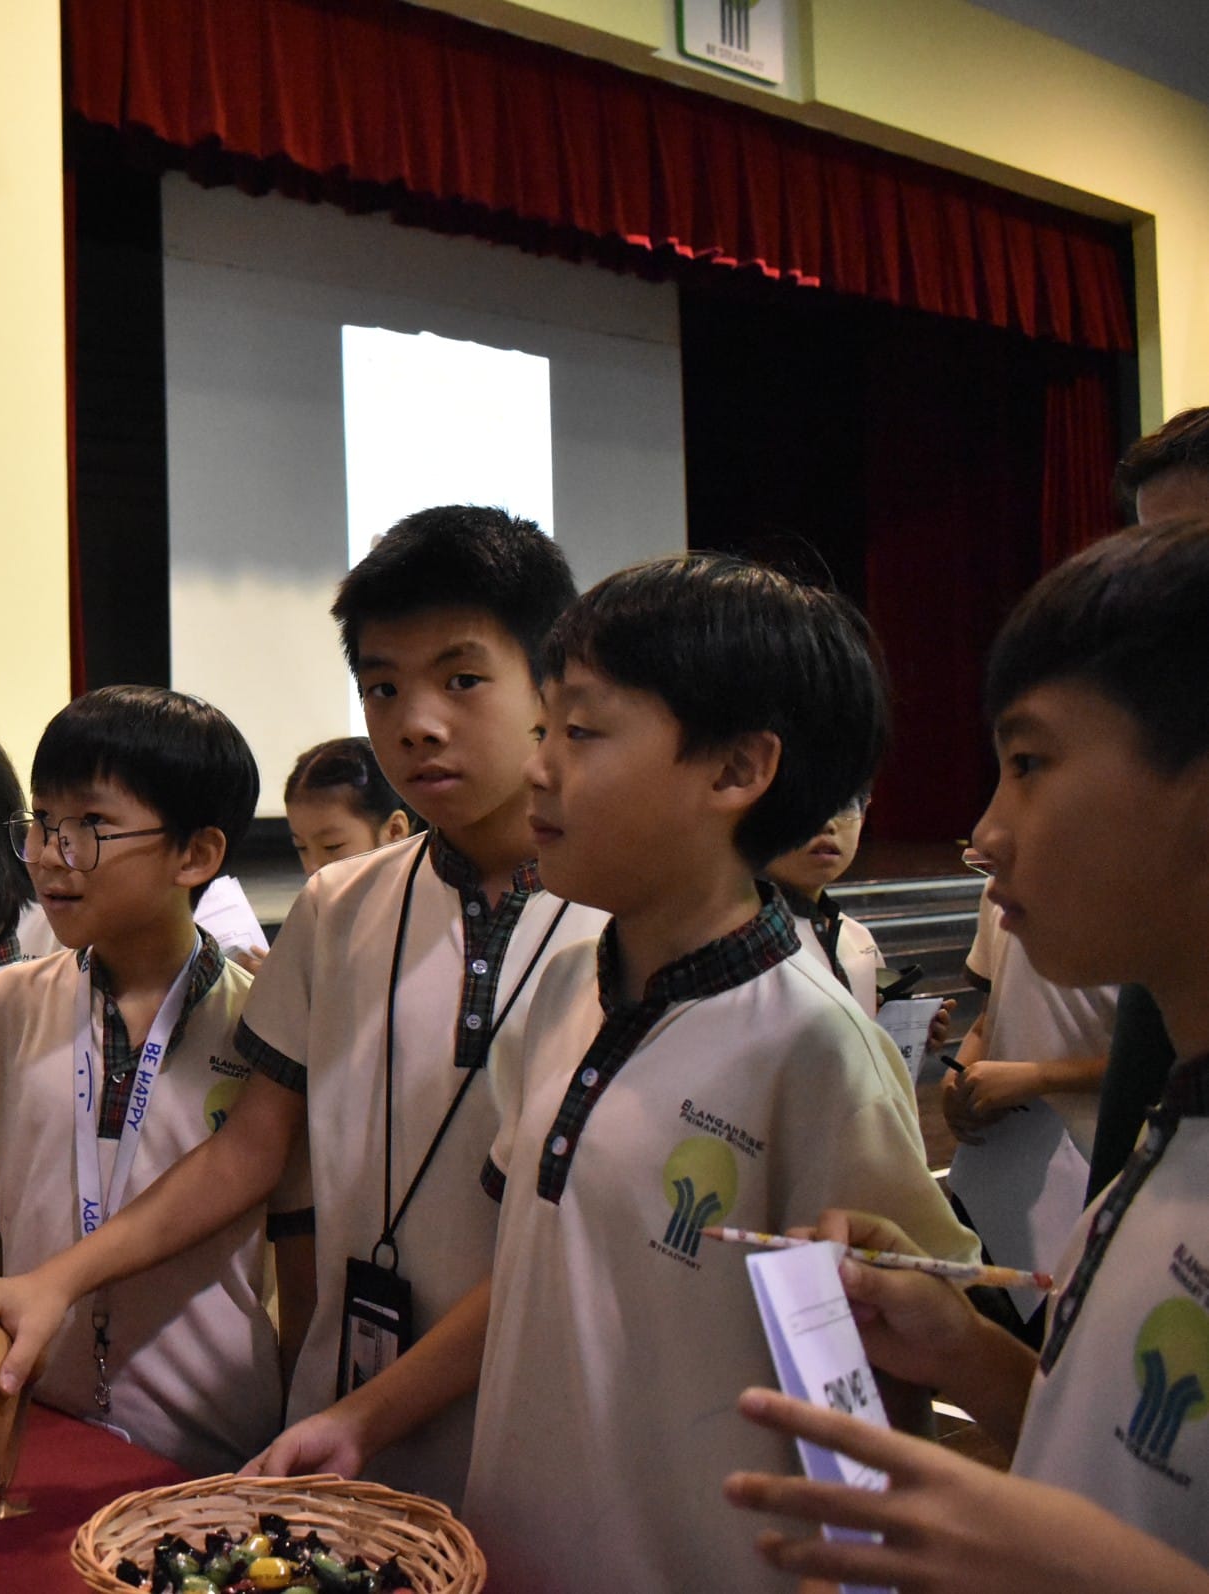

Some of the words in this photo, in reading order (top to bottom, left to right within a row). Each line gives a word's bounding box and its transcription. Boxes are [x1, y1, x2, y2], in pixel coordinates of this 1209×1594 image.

[143, 1041, 162, 1067] BE
[126, 1071, 154, 1132] HAPPY
[681, 1098, 741, 1135] BLANGAH
[679, 1111, 724, 1137] PRIMARY
[725, 1132, 758, 1159] SCHOOL
[648, 1239, 702, 1272] STEADFAST
